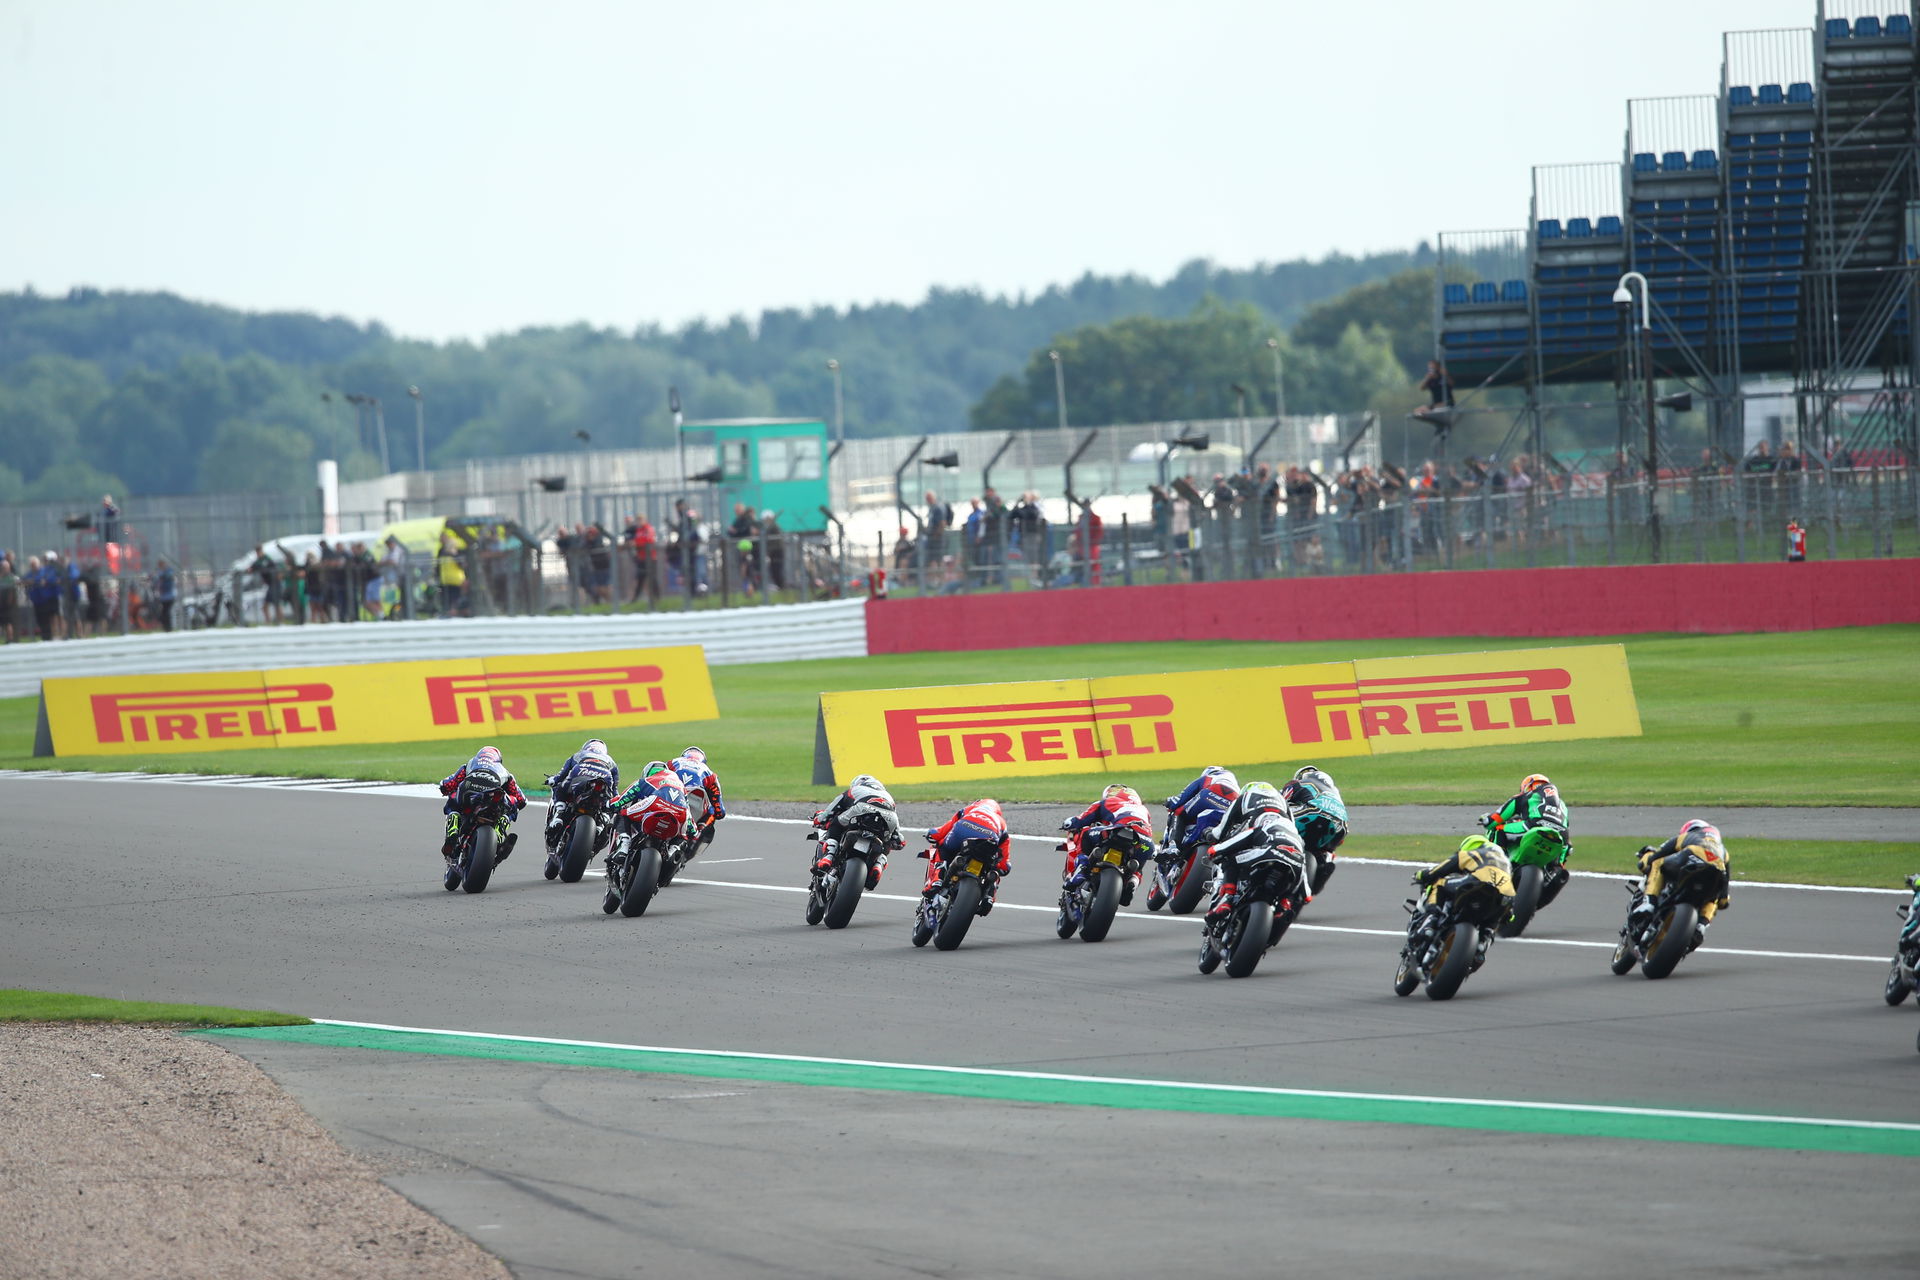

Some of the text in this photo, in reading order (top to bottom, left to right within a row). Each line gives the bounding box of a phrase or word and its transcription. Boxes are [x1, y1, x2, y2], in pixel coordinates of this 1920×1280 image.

[90, 682, 335, 742] PIRELLI
[426, 665, 666, 724] PIRELLI
[1281, 667, 1575, 742] PIRELLI
[884, 694, 1177, 768] PIRELLI
